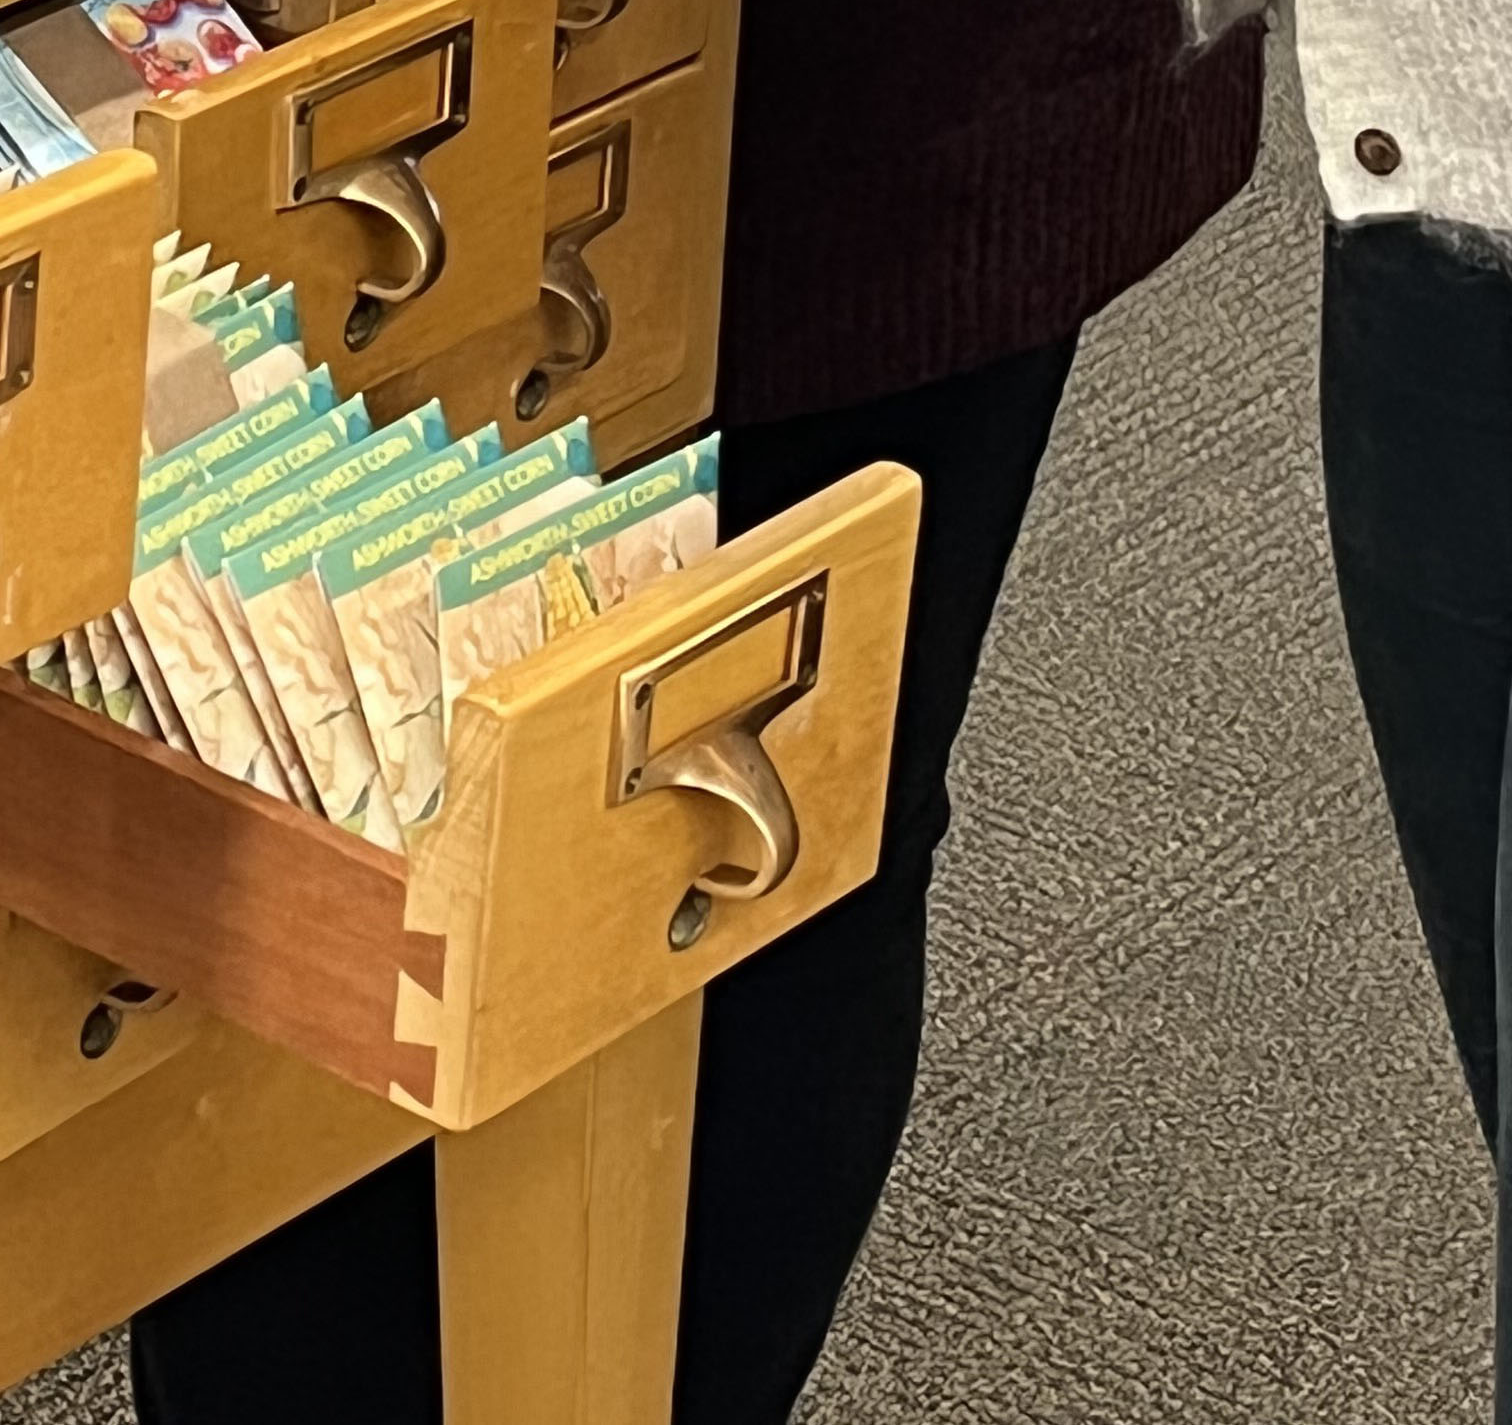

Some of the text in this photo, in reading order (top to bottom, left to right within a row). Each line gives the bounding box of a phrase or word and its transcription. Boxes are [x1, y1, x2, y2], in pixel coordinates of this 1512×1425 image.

[196, 423, 252, 468] SWEET
[248, 397, 299, 437] CORN
[142, 430, 336, 555] ASHWORTH SWEET CORN
[220, 436, 413, 551] ASHWORTH SWEET CORN
[261, 456, 466, 573] ASHWORTH SWEET CORN
[352, 453, 554, 571] ASHWORTH SWEET CORN
[470, 469, 681, 585] ASHWORTH SWEET CORN
